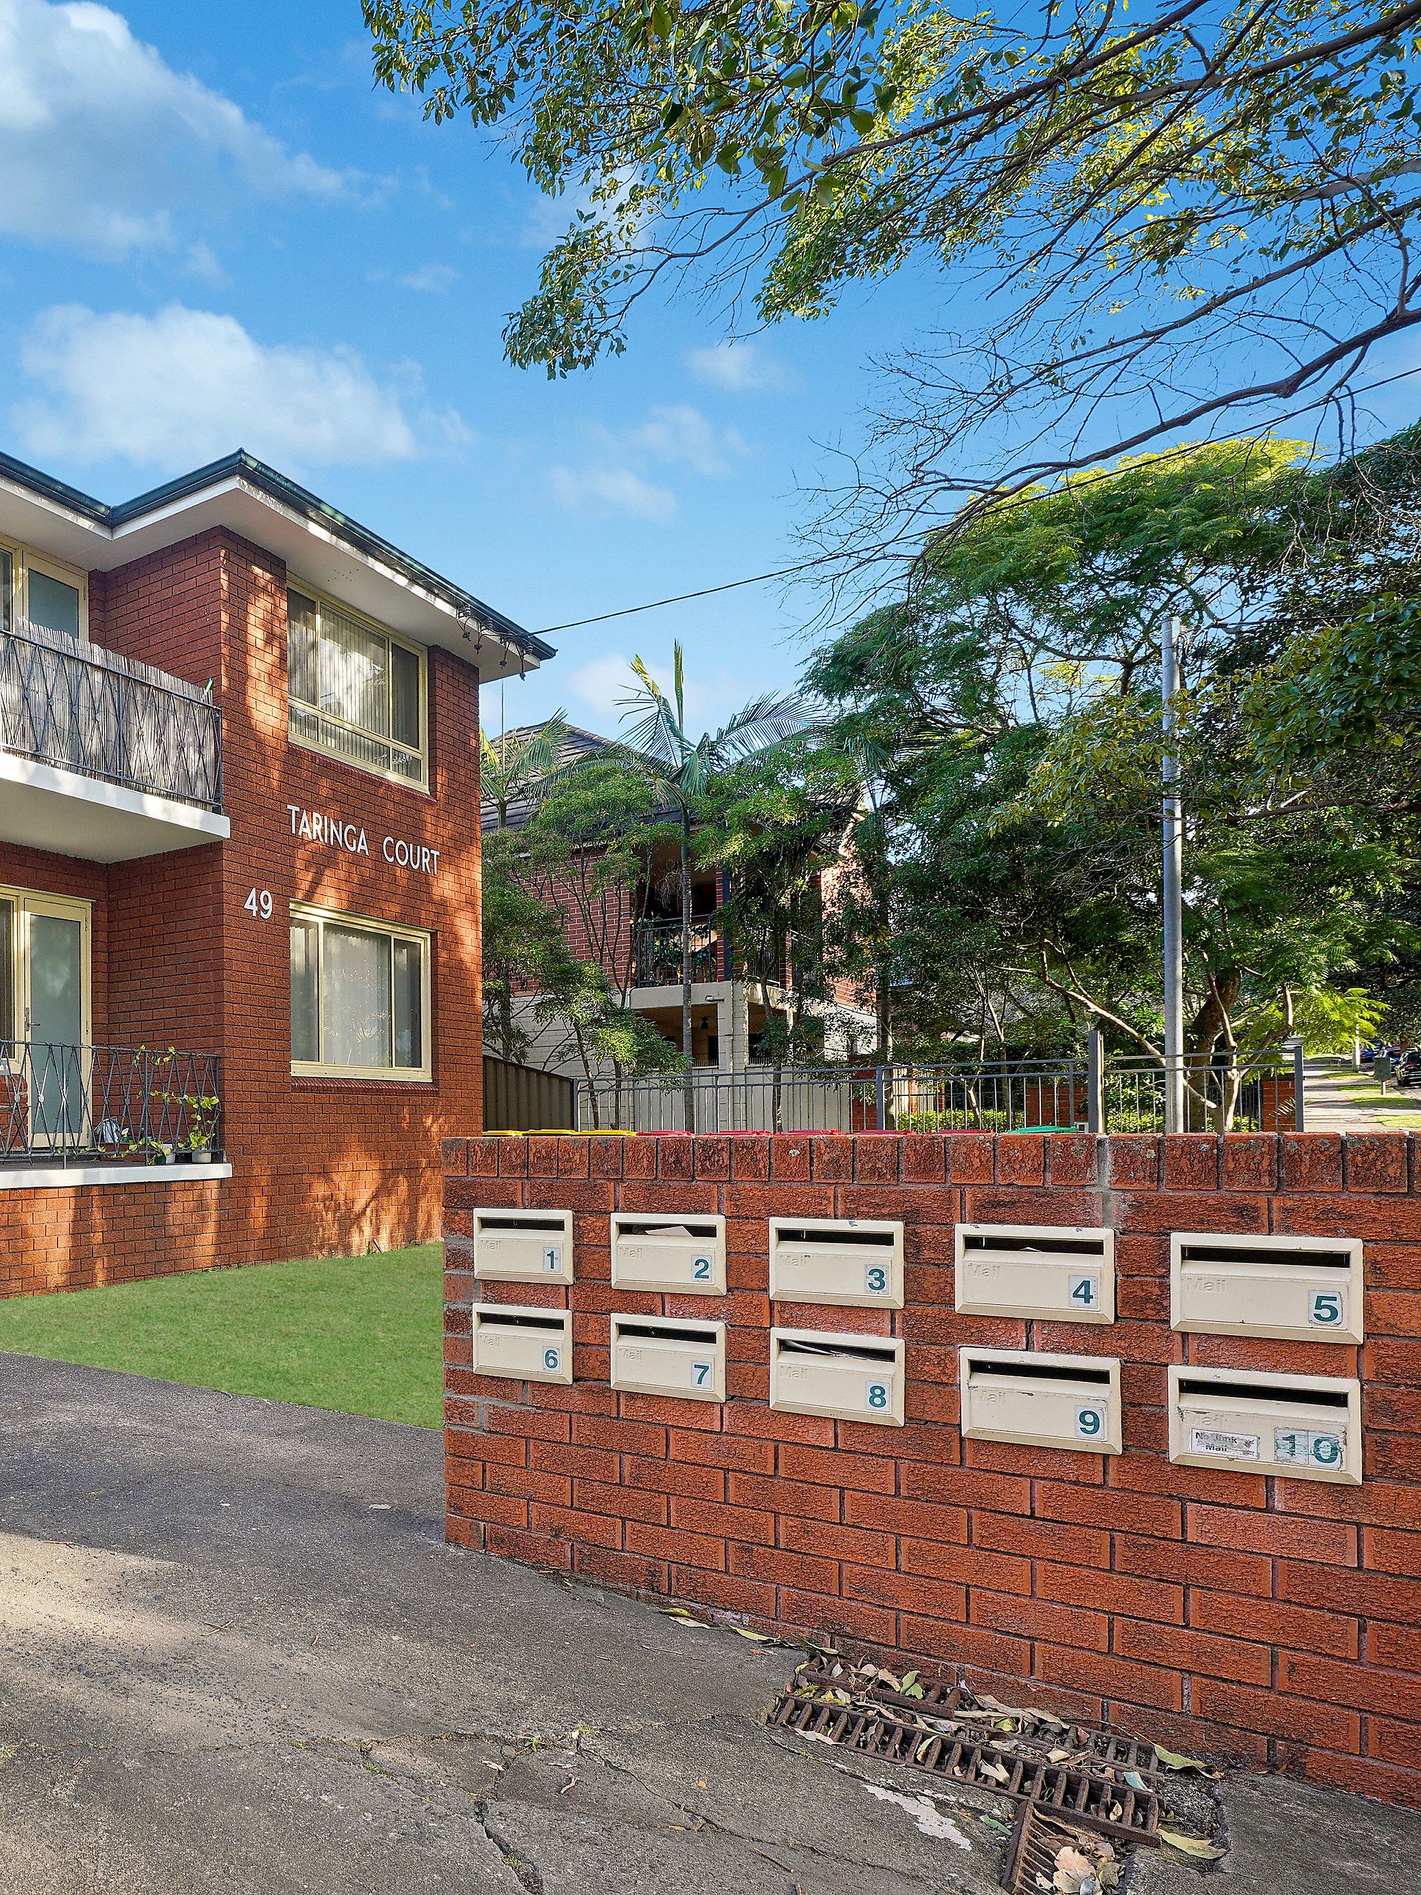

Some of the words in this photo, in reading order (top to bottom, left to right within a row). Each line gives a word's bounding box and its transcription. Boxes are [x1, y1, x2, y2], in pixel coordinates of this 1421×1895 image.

[286, 804, 370, 857] TARINGA
[382, 836, 441, 876] COURT
[243, 887, 274, 920] 49
[545, 1249, 556, 1270] 1
[618, 1245, 644, 1259] Mail
[693, 1257, 710, 1280] 2
[867, 1268, 886, 1291] 3
[1071, 1279, 1094, 1304] 4
[1186, 1276, 1228, 1294] Mail
[1312, 1294, 1339, 1323] 5
[543, 1348, 558, 1369] 6
[693, 1363, 710, 1385] 7
[780, 1365, 808, 1380] Mail
[868, 1385, 887, 1408] 8
[1078, 1409, 1101, 1435] 9
[1279, 1433, 1340, 1465] 10
